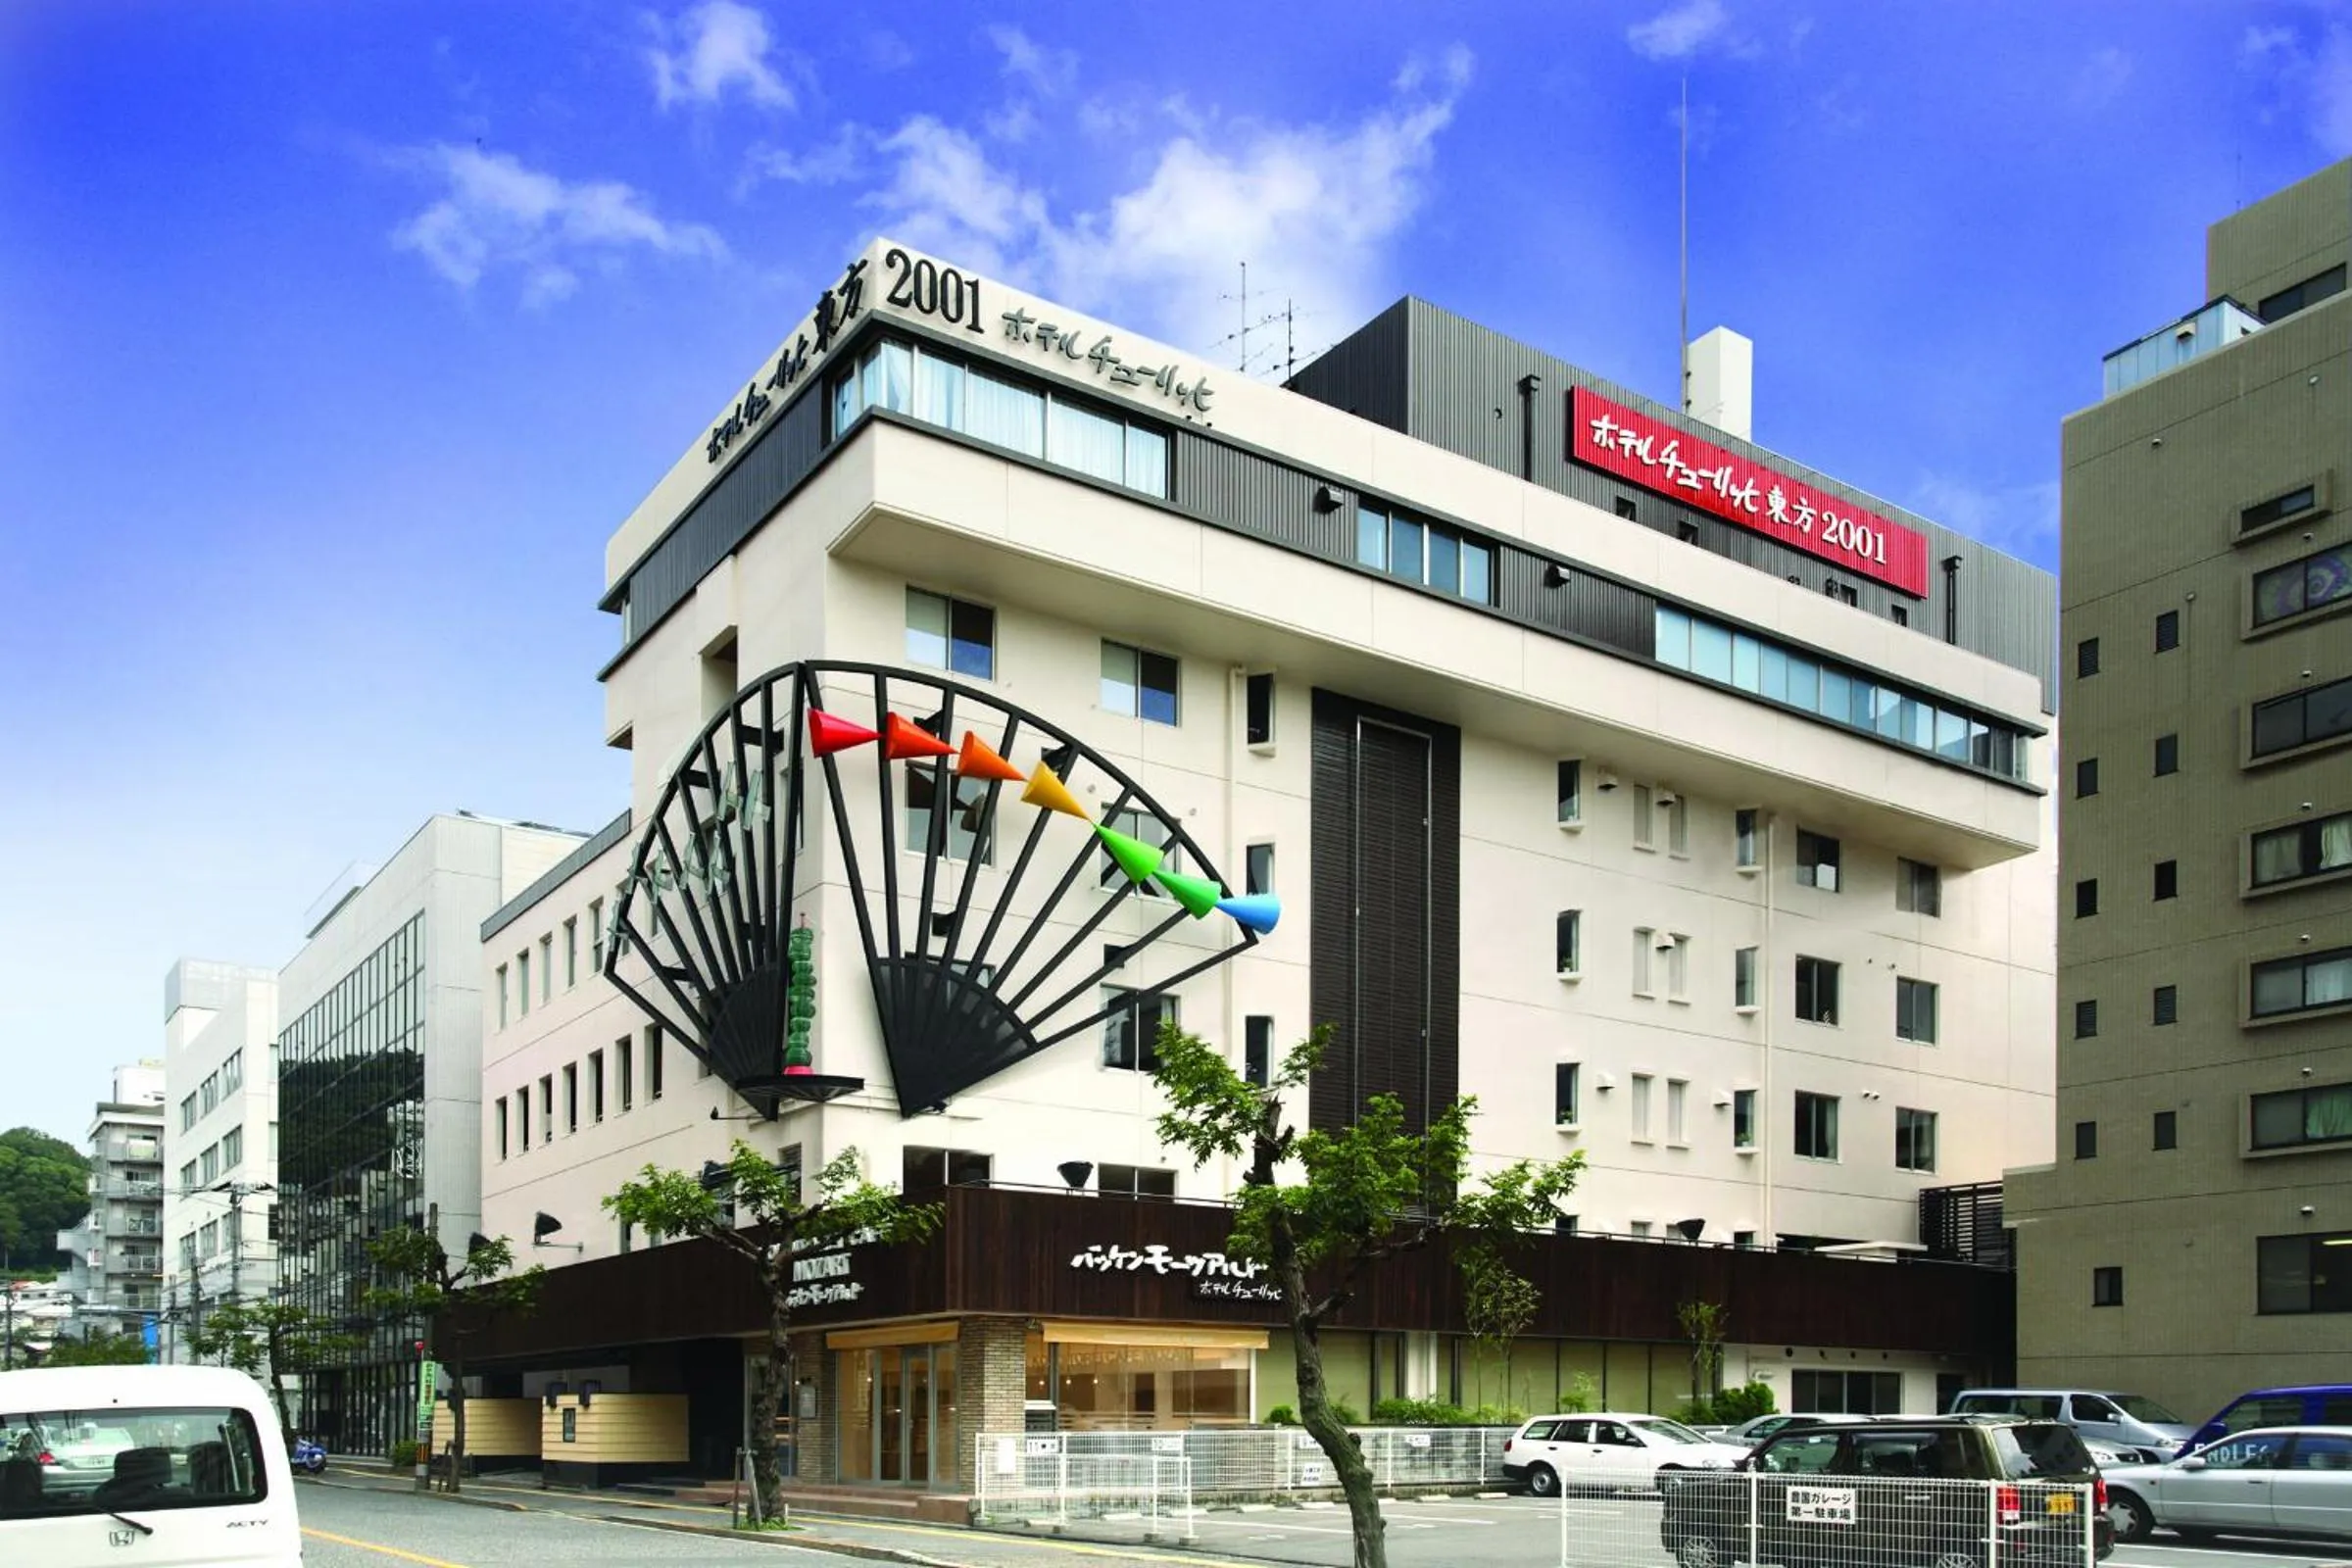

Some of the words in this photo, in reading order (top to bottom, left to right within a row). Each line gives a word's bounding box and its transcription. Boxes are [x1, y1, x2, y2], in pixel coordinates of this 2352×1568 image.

[885, 248, 985, 334] 2001
[1002, 307, 1215, 412] ホテルチューリッヒ
[1590, 415, 1761, 514] ホテルチューリッヒ
[1765, 485, 1816, 534] 東方
[1821, 511, 1887, 564] 2001
